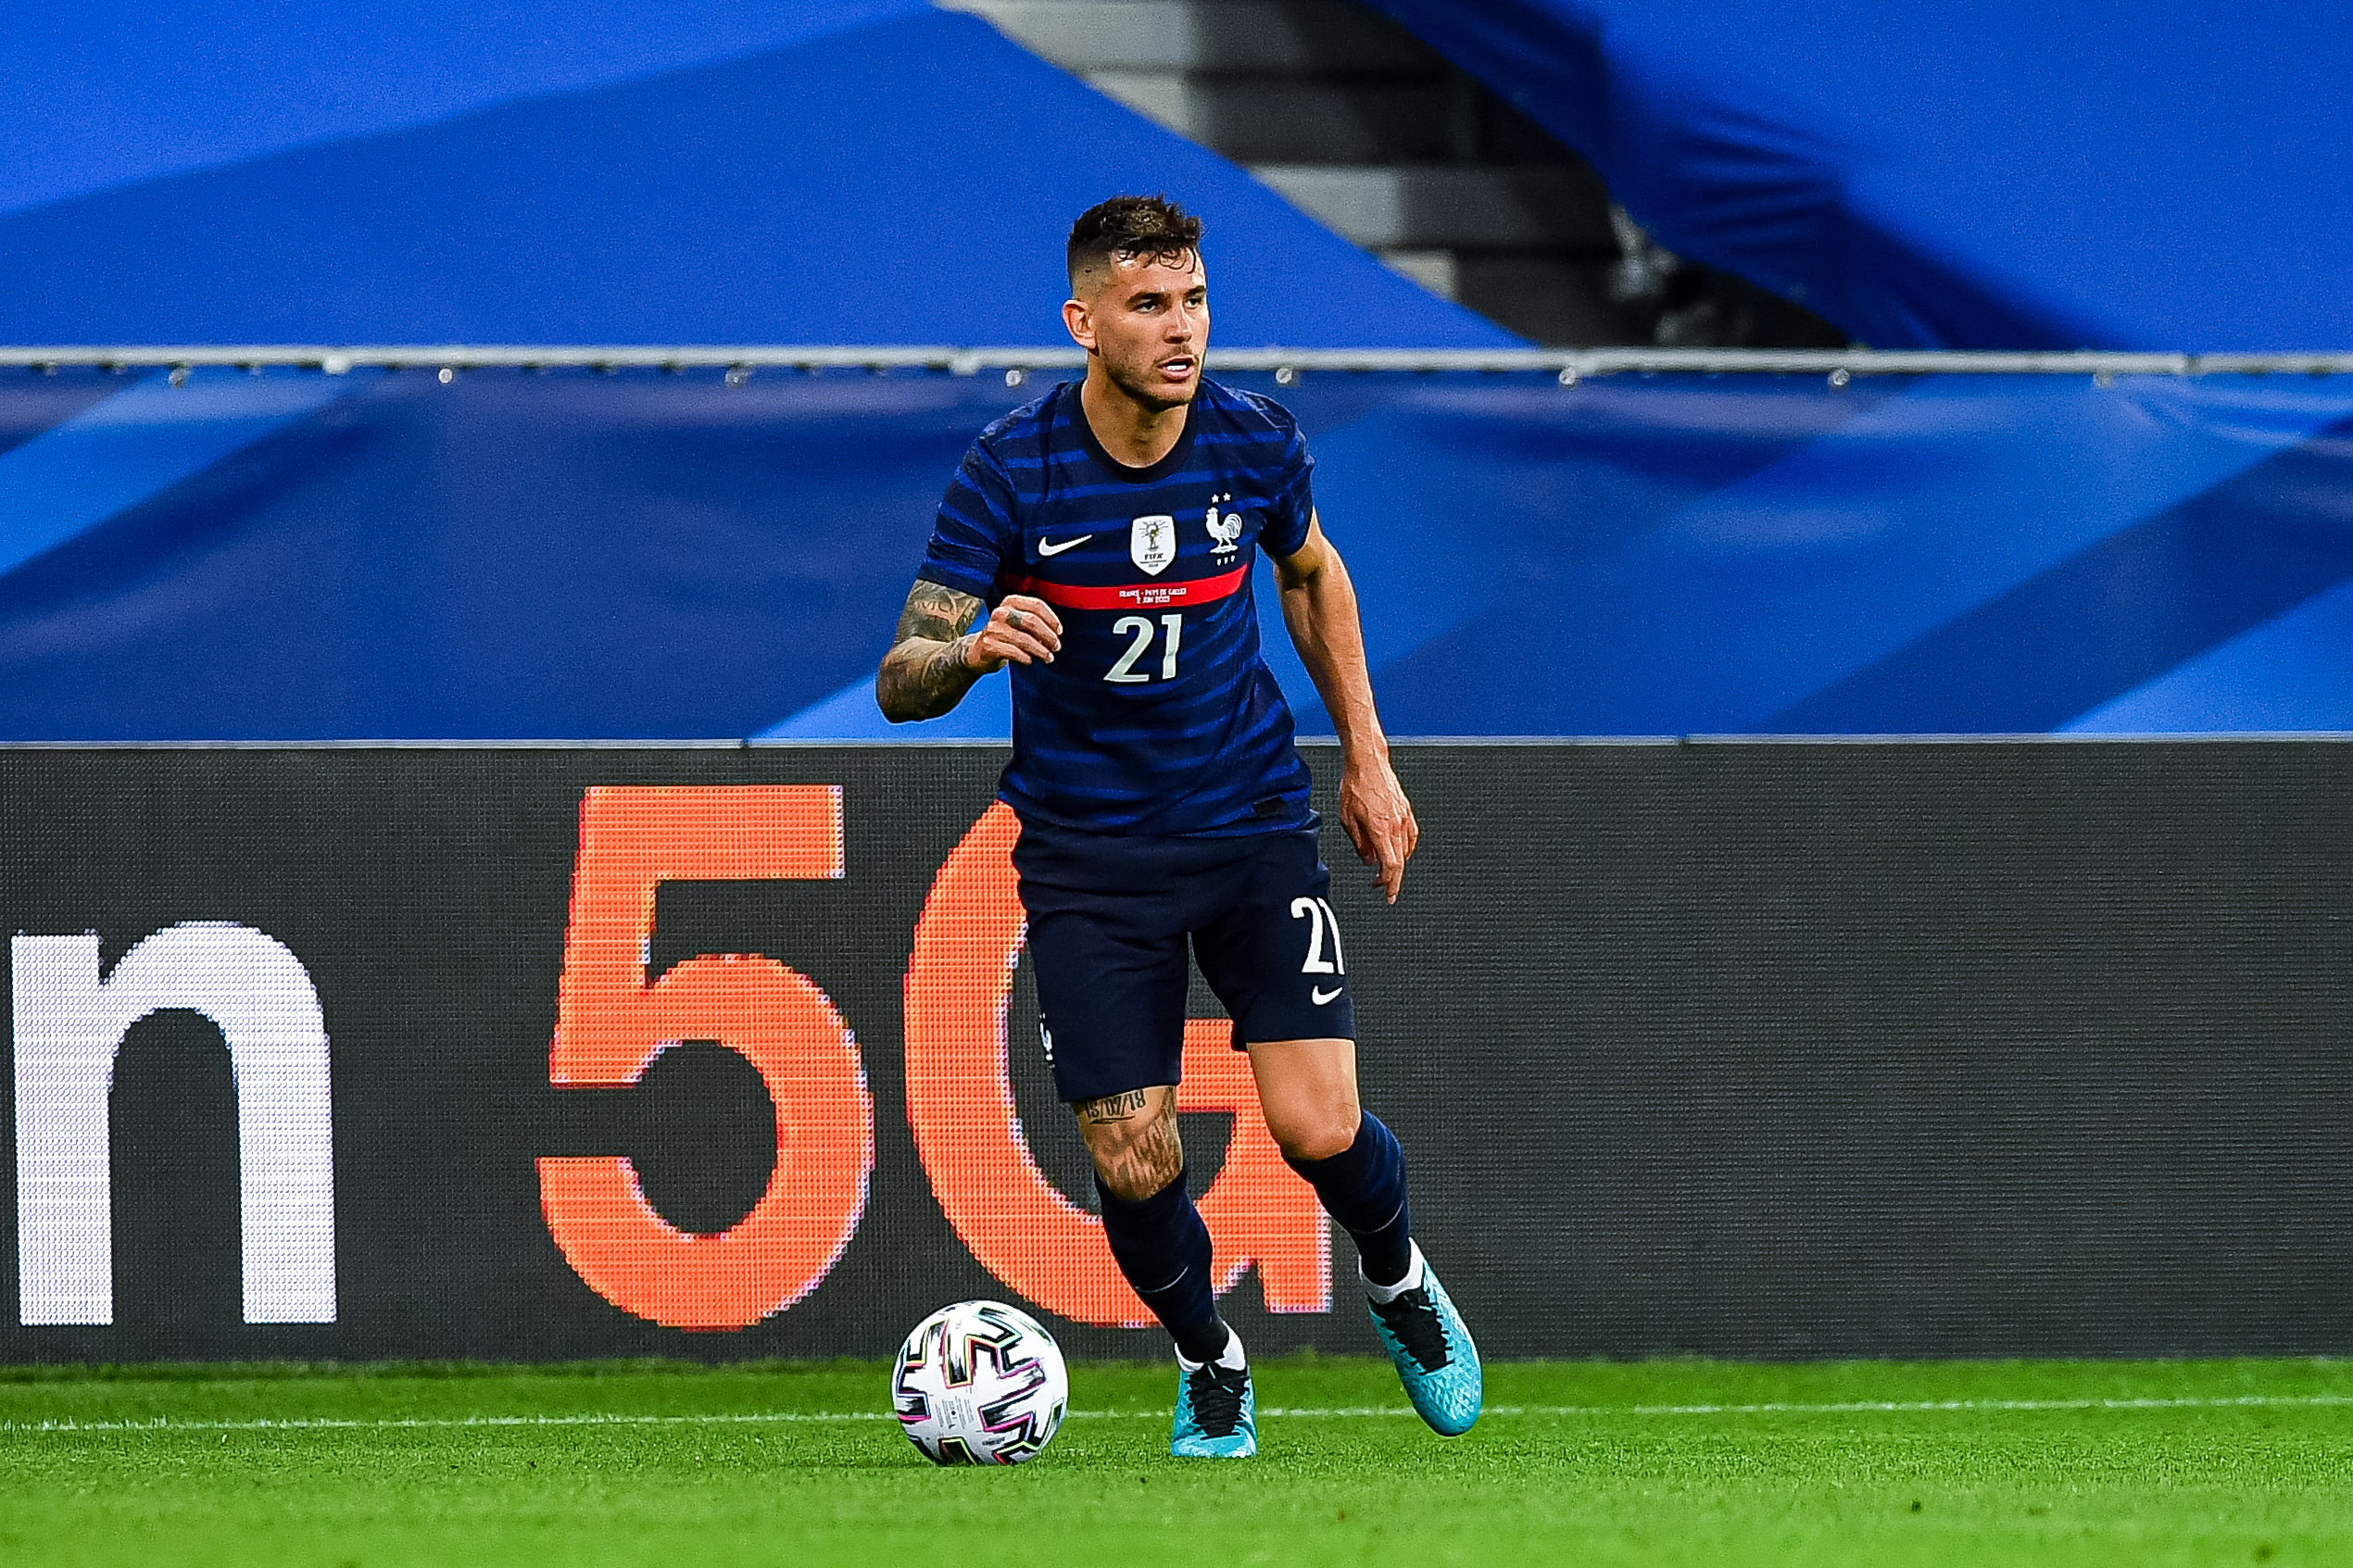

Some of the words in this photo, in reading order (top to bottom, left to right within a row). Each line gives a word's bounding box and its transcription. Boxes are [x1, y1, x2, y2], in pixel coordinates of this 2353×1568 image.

[1103, 613, 1182, 683] 21
[1290, 896, 1346, 976] 21
[537, 784, 1333, 1330] 5G
